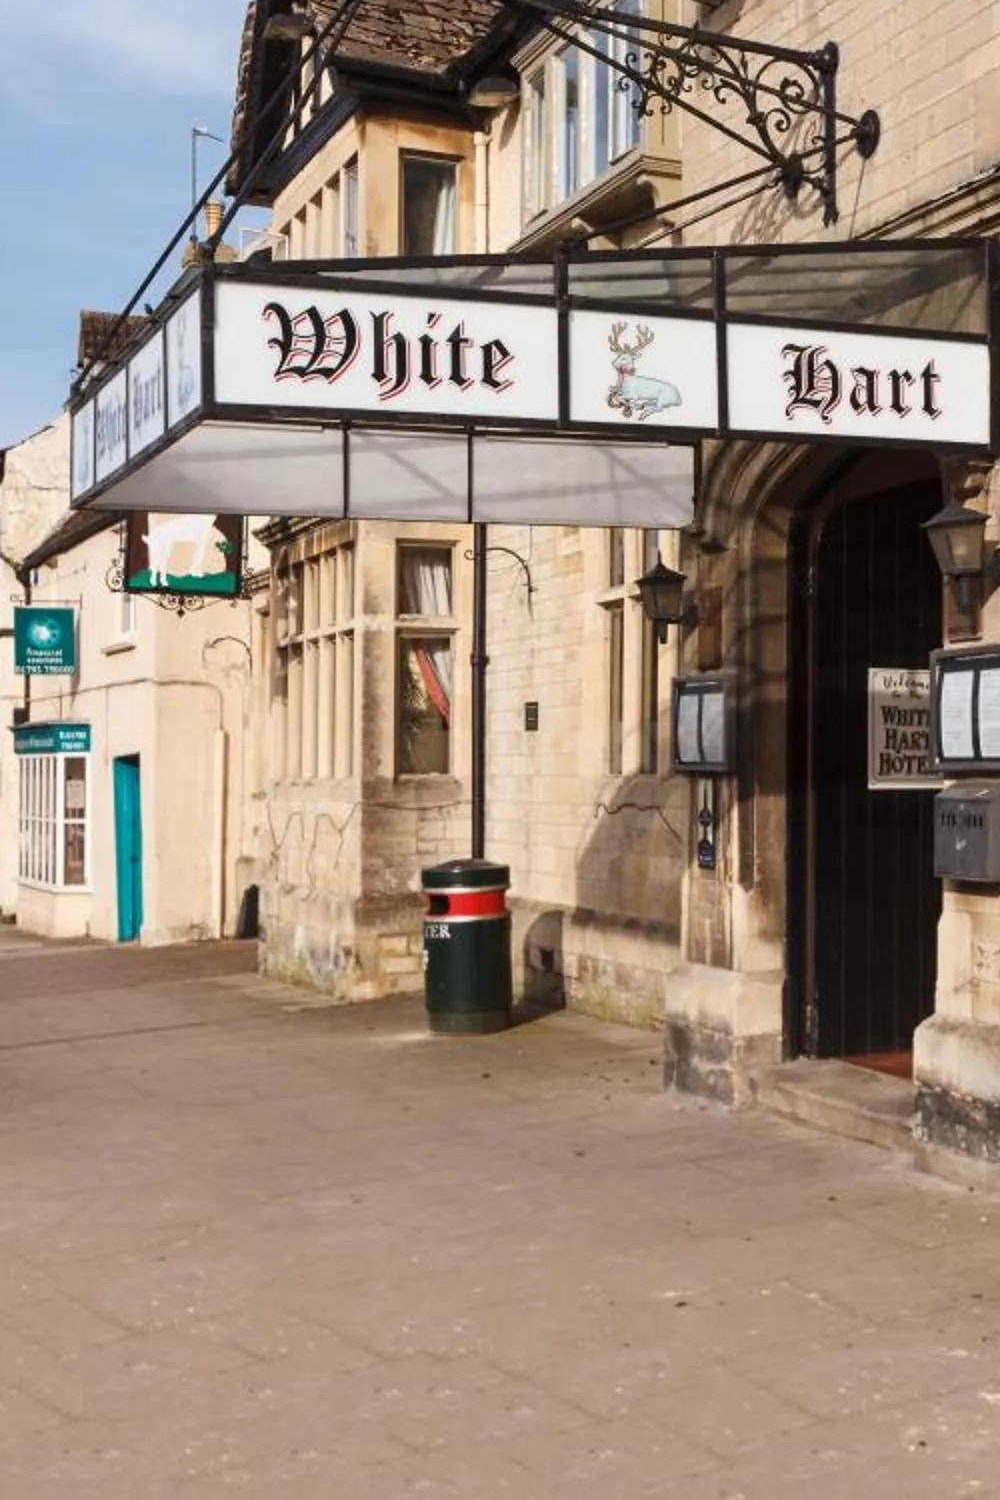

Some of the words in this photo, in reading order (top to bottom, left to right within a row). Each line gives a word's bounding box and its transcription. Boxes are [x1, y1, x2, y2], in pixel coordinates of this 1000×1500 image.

[262, 302, 515, 400] White
[781, 343, 943, 424] Hart
[879, 752, 930, 776] HOTE
